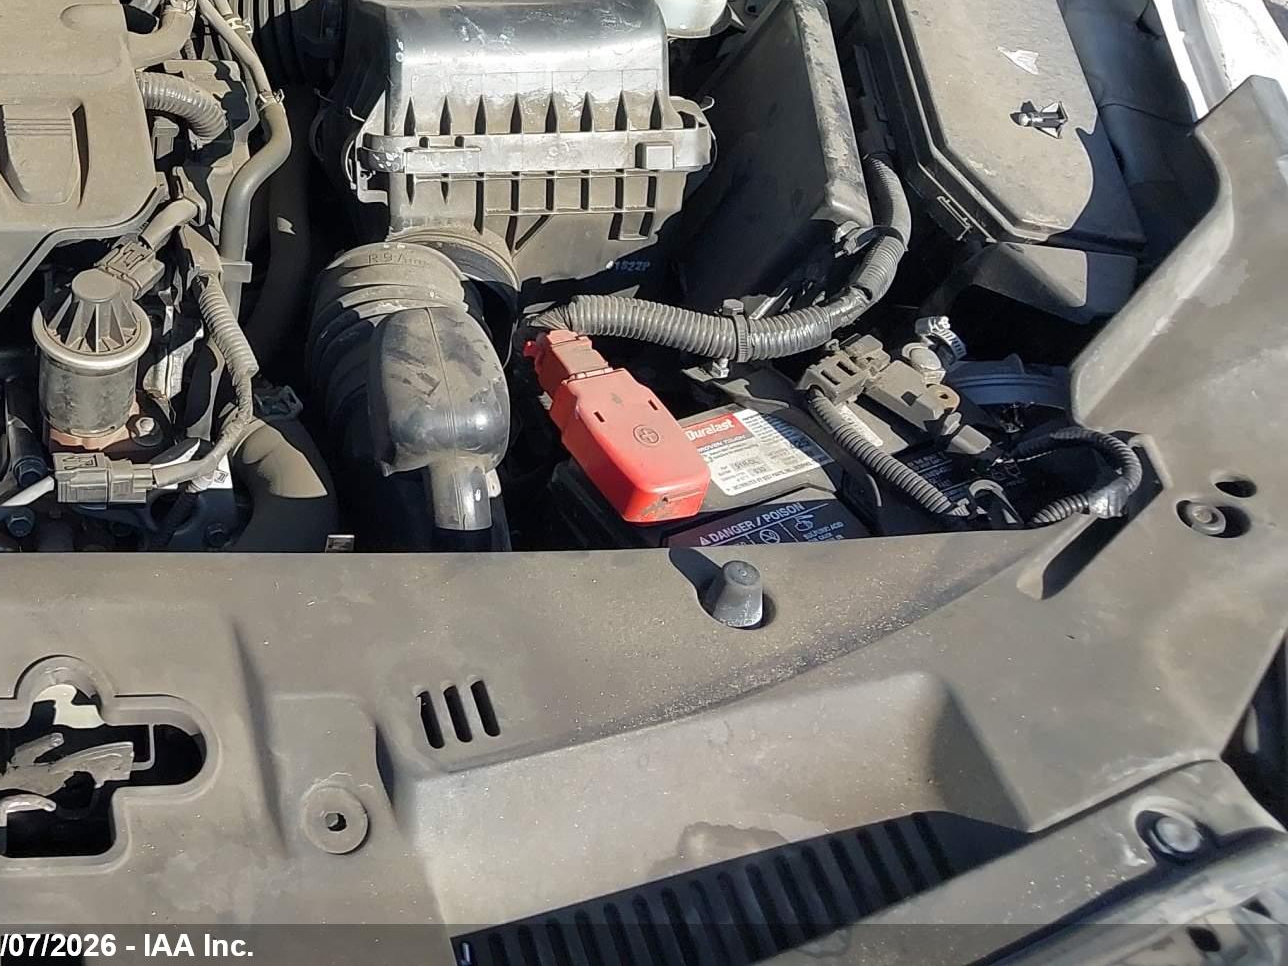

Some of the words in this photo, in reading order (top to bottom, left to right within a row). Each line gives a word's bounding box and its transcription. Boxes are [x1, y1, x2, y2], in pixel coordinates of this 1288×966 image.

[685, 419, 735, 442] Duralast
[708, 520, 755, 542] DANGER
[763, 502, 806, 523] POISON
